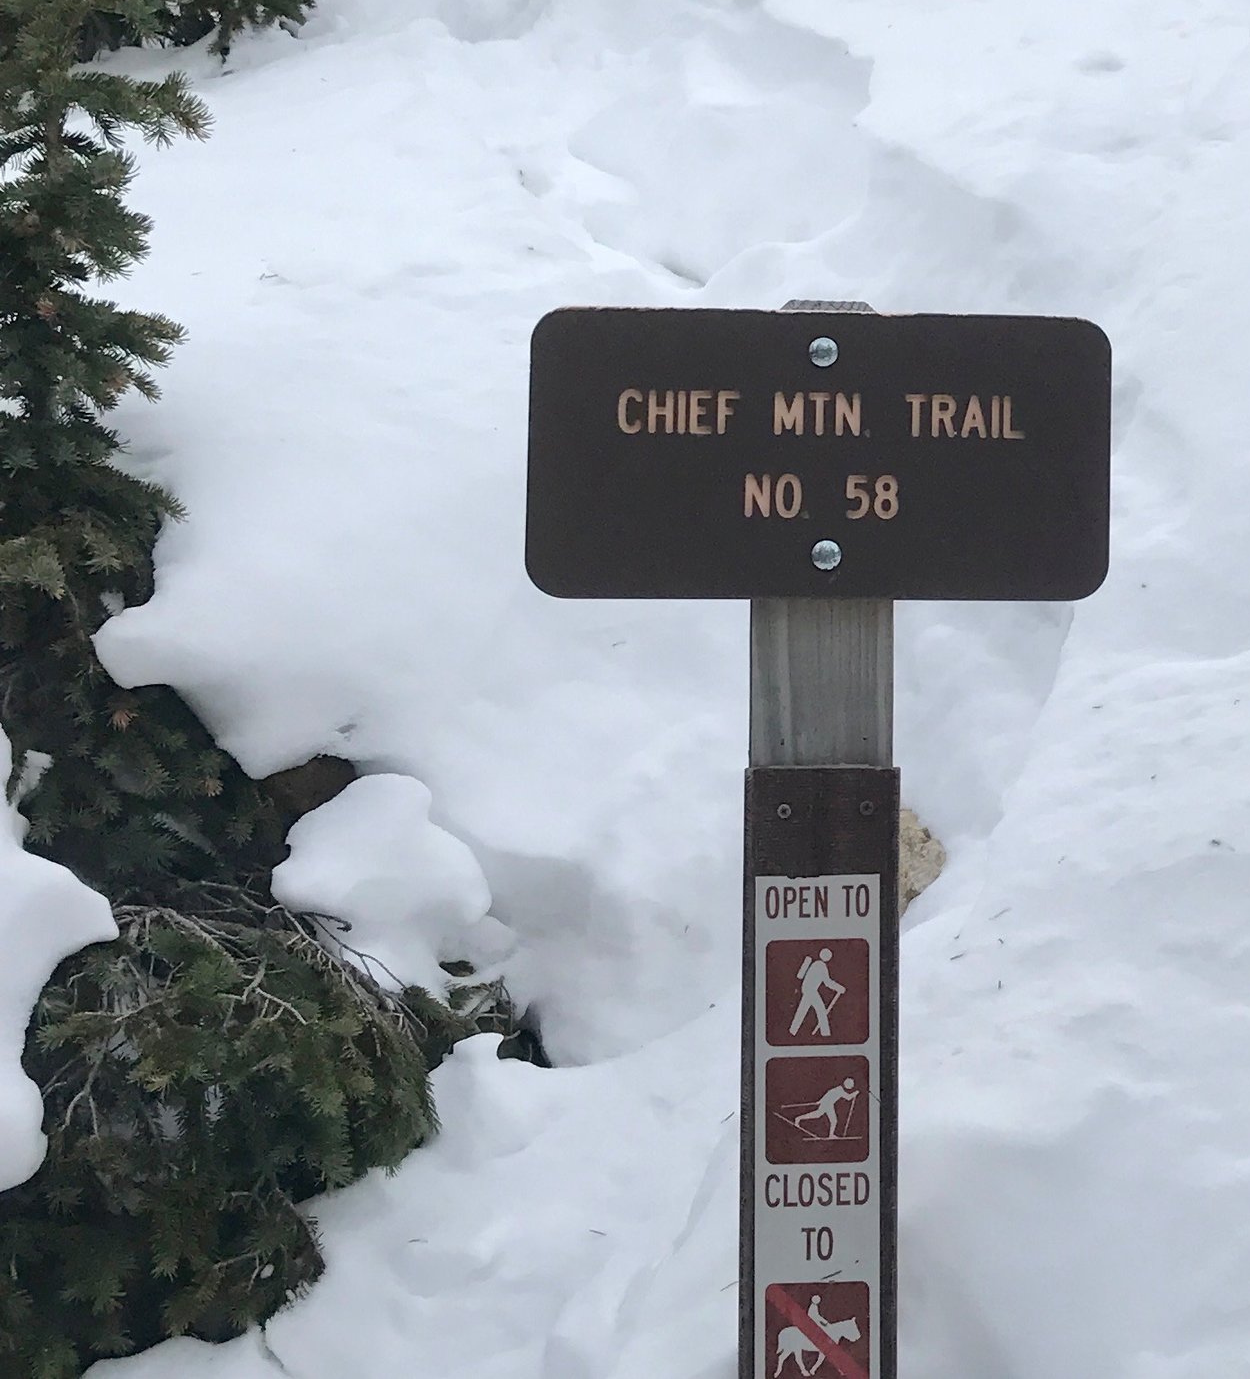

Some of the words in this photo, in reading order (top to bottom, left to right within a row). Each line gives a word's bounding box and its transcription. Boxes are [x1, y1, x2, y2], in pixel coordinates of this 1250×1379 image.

[616, 389, 739, 435] CHIEF
[905, 394, 1025, 439] TRAIL
[846, 474, 899, 519] 58
[765, 885, 829, 919] OPEN
[841, 884, 870, 918] TO
[765, 1172, 870, 1208] CLOSED
[801, 1226, 834, 1261] TO
